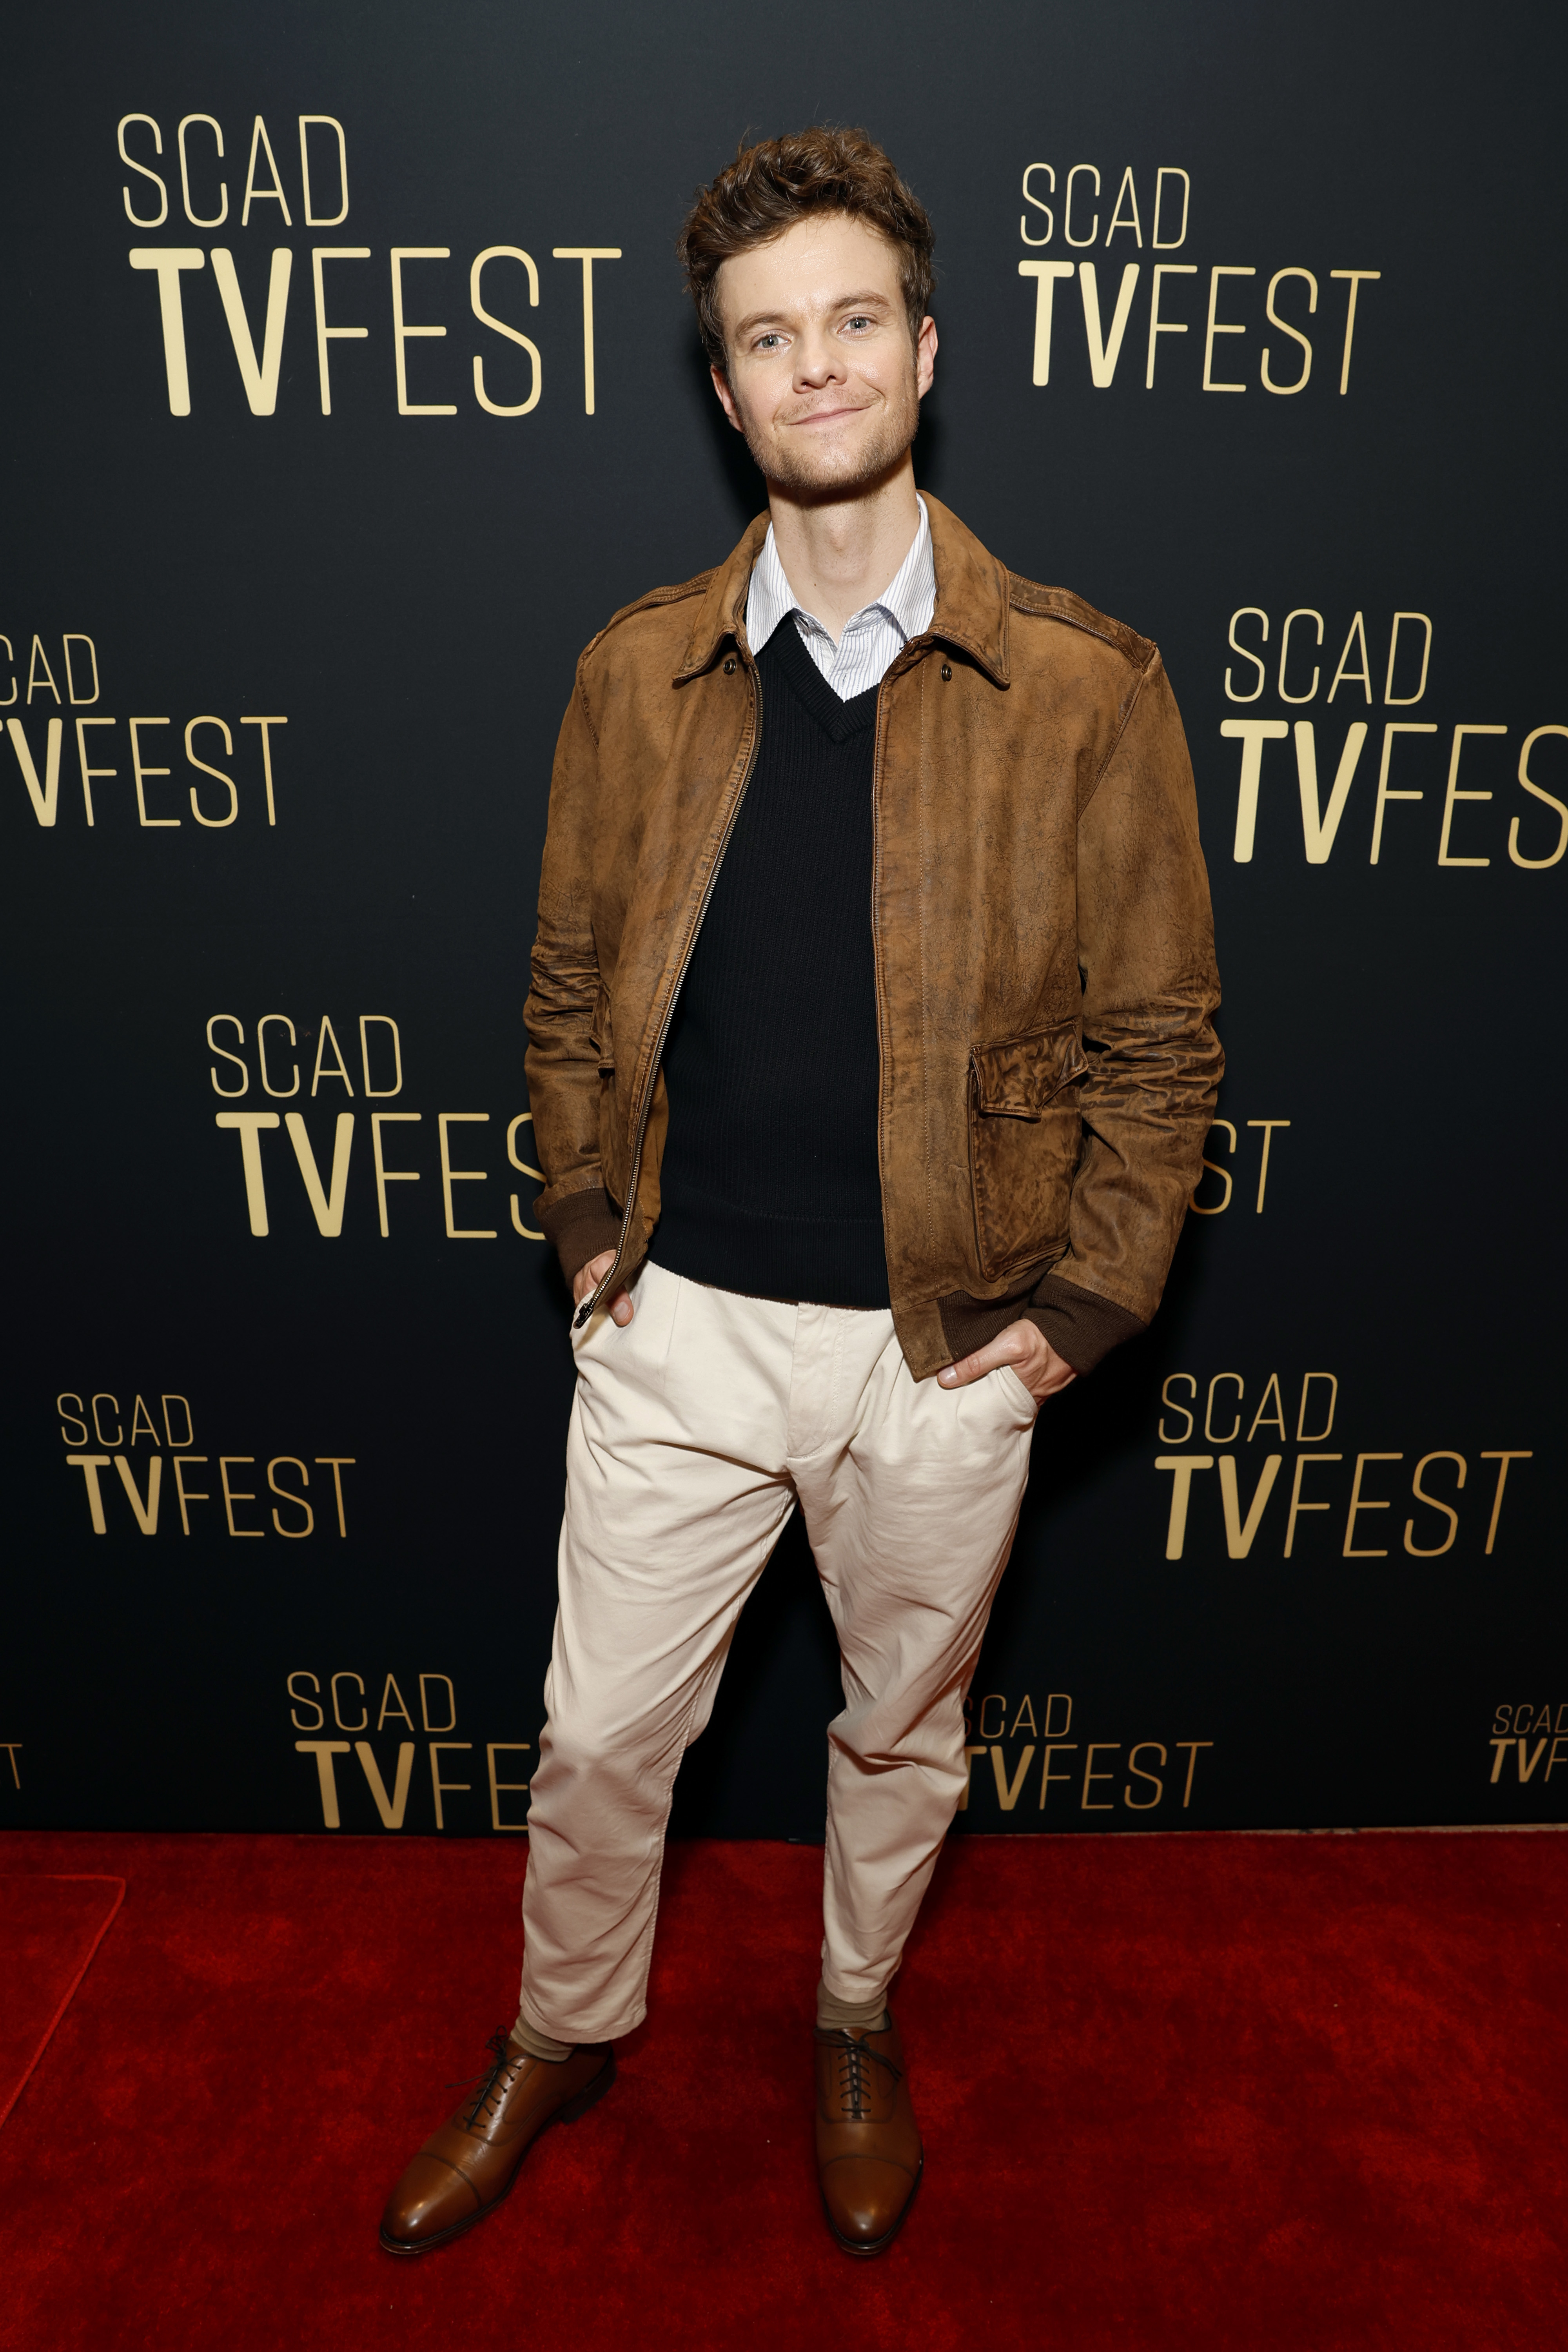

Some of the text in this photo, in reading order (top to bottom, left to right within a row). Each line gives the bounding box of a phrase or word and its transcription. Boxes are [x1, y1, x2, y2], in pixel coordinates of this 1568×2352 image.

[118, 114, 348, 227] SCAD
[1020, 163, 1190, 249] SCAD
[129, 247, 622, 417] TVFEST
[1018, 260, 1381, 395] TVFEST
[1225, 607, 1432, 705] SCAD
[0, 716, 288, 827] VFEST
[1220, 719, 1568, 869] TVFES
[207, 1014, 402, 1098] SCAD
[57, 1394, 193, 1446] SCAD
[1159, 1373, 1337, 1443] SCAD
[67, 1455, 355, 1537] TVFEST
[1155, 1452, 1532, 1560] TVFEST
[288, 1672, 455, 1731] SCAD
